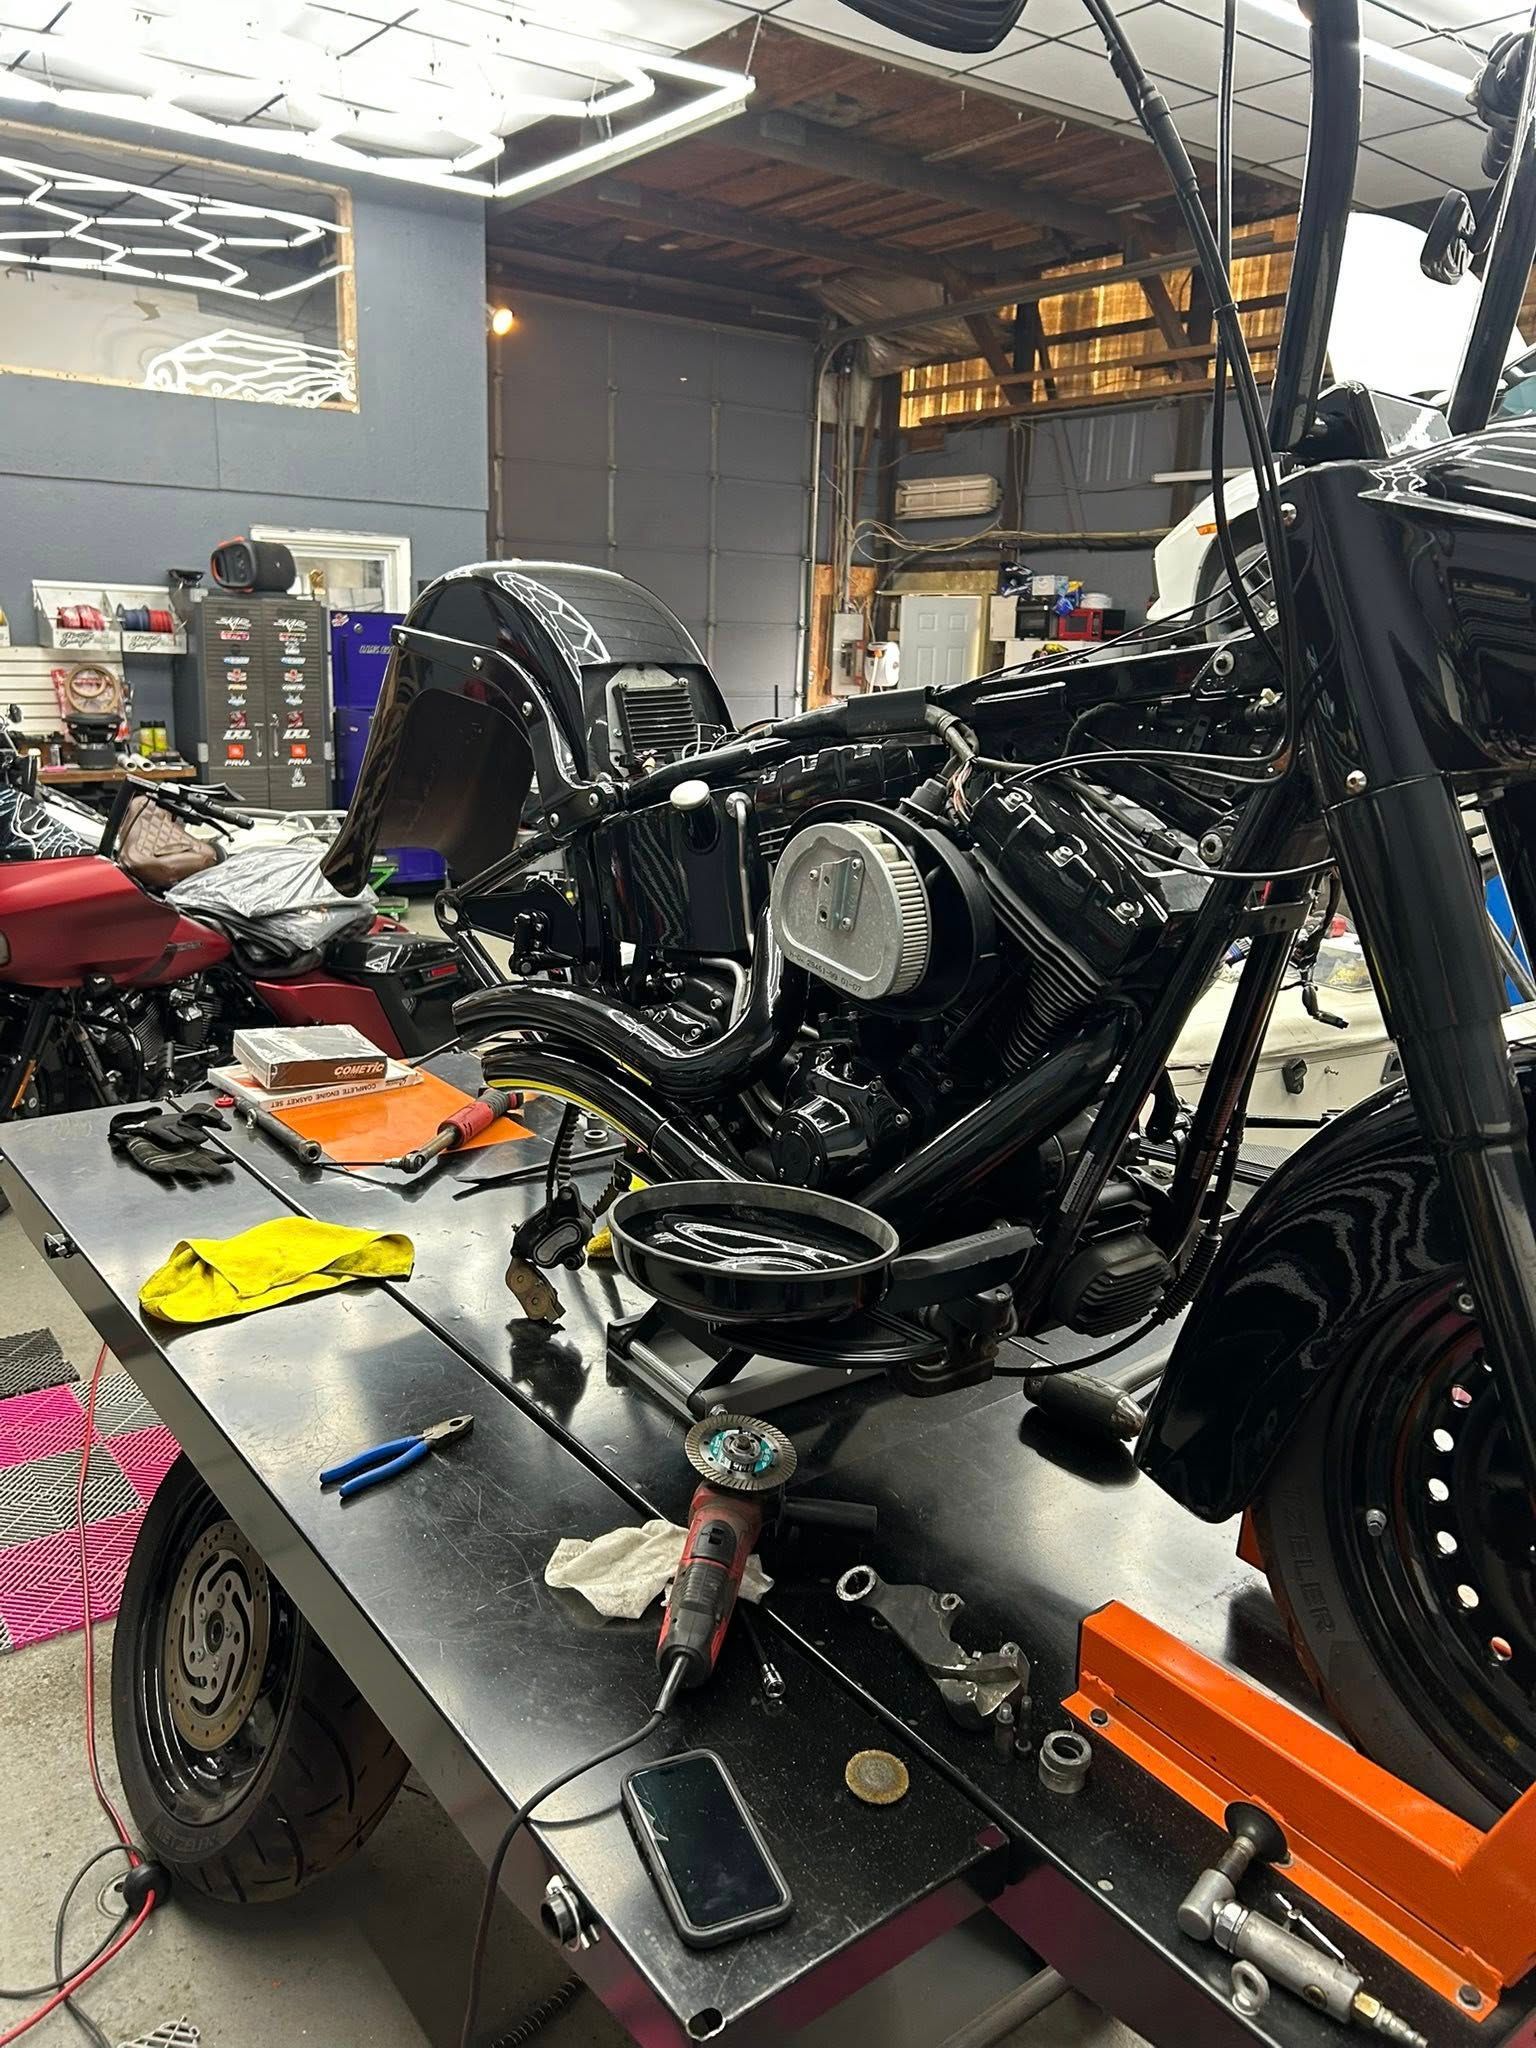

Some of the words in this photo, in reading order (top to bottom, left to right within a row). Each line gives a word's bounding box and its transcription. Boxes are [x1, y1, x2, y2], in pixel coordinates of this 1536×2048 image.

[334, 1062, 385, 1075] COMETIC
[342, 1083, 377, 1094] COMPLETE
[286, 1095, 313, 1105] GASKET
[316, 1089, 340, 1100] ENGINE
